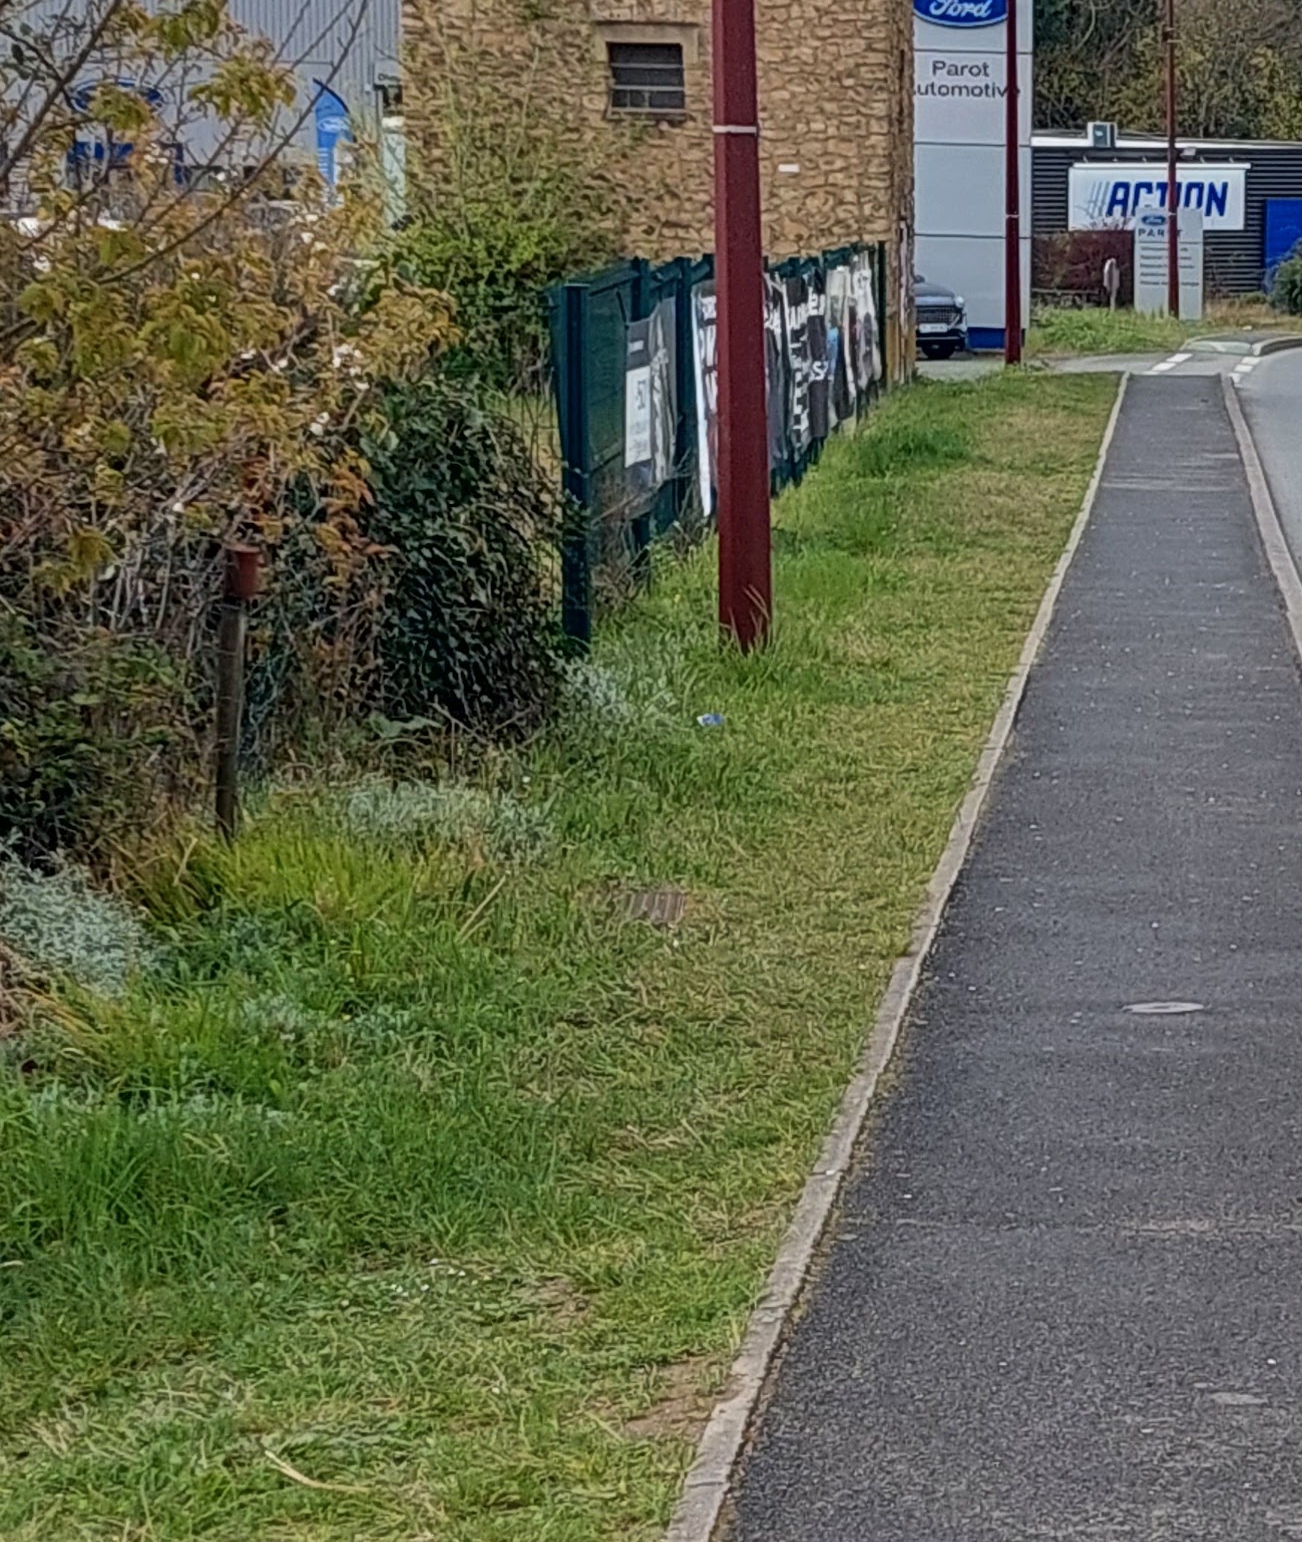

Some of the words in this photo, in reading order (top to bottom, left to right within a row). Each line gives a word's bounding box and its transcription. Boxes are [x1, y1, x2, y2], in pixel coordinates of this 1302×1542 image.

[932, 60, 990, 78] Parot
[912, 81, 1021, 99] utomotiv
[1138, 228, 1182, 237] PART
